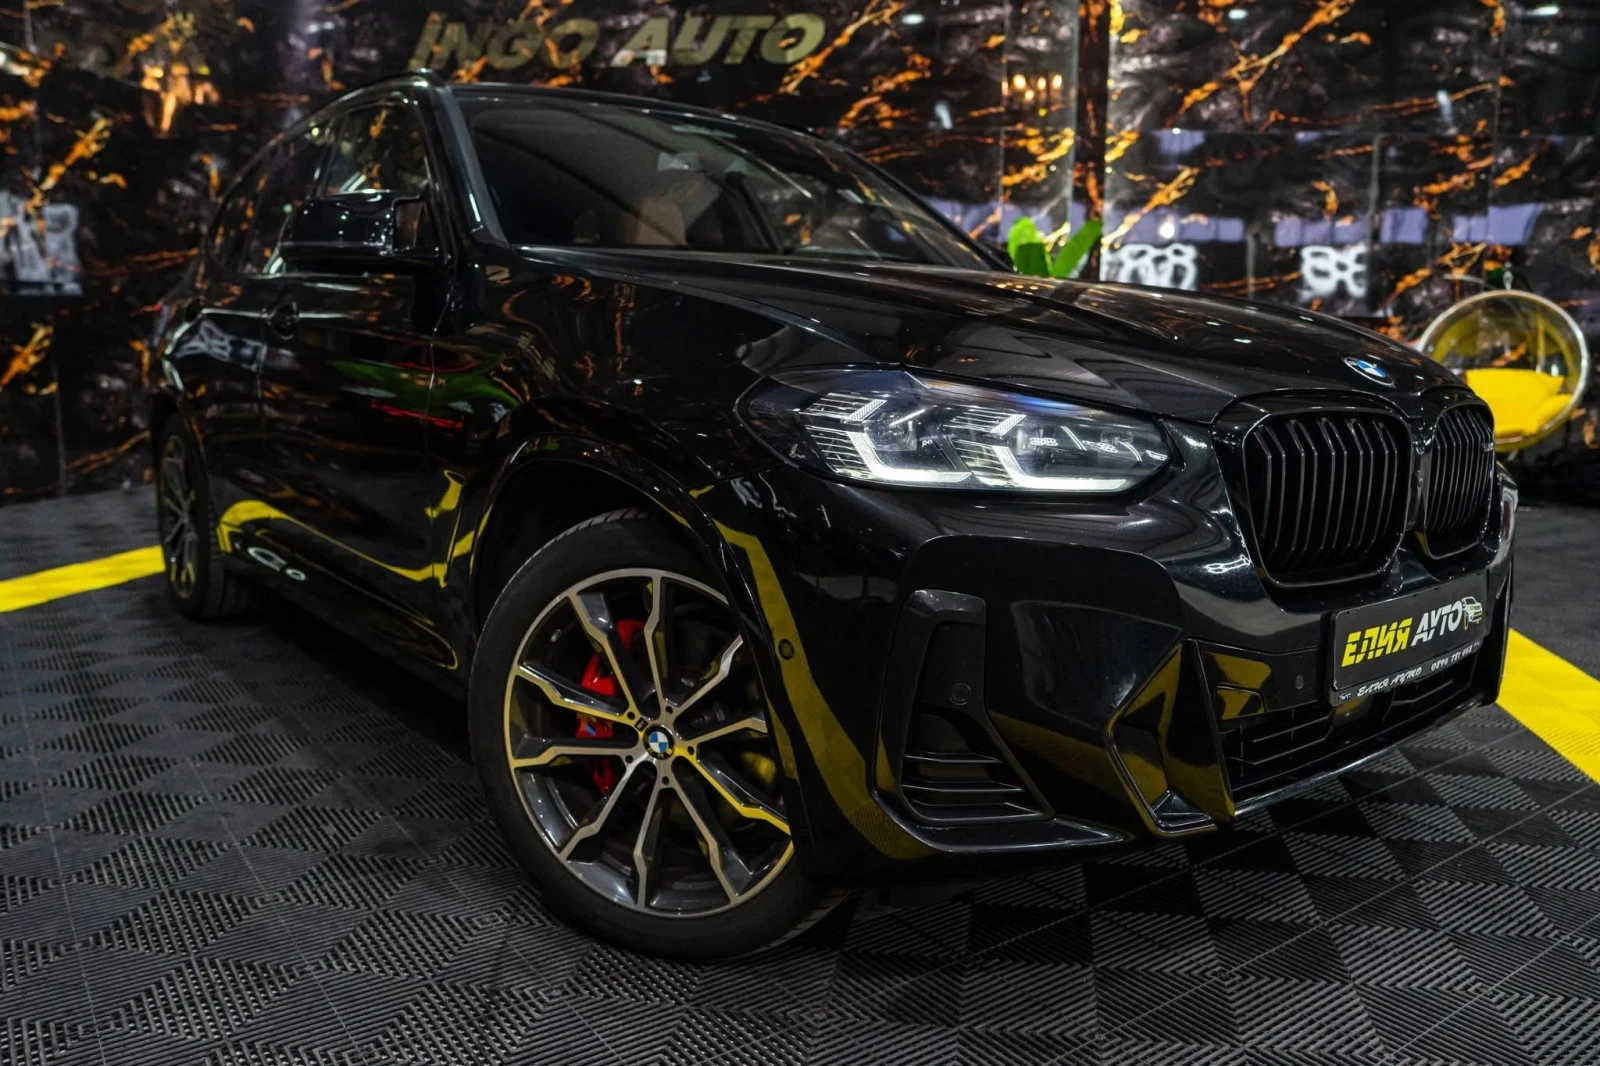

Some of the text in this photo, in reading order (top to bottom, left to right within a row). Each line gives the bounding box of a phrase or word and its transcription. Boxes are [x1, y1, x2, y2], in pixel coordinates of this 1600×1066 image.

[410, 11, 826, 71] INGO AUTO
[1341, 616, 1414, 668] ЕЛИЯ
